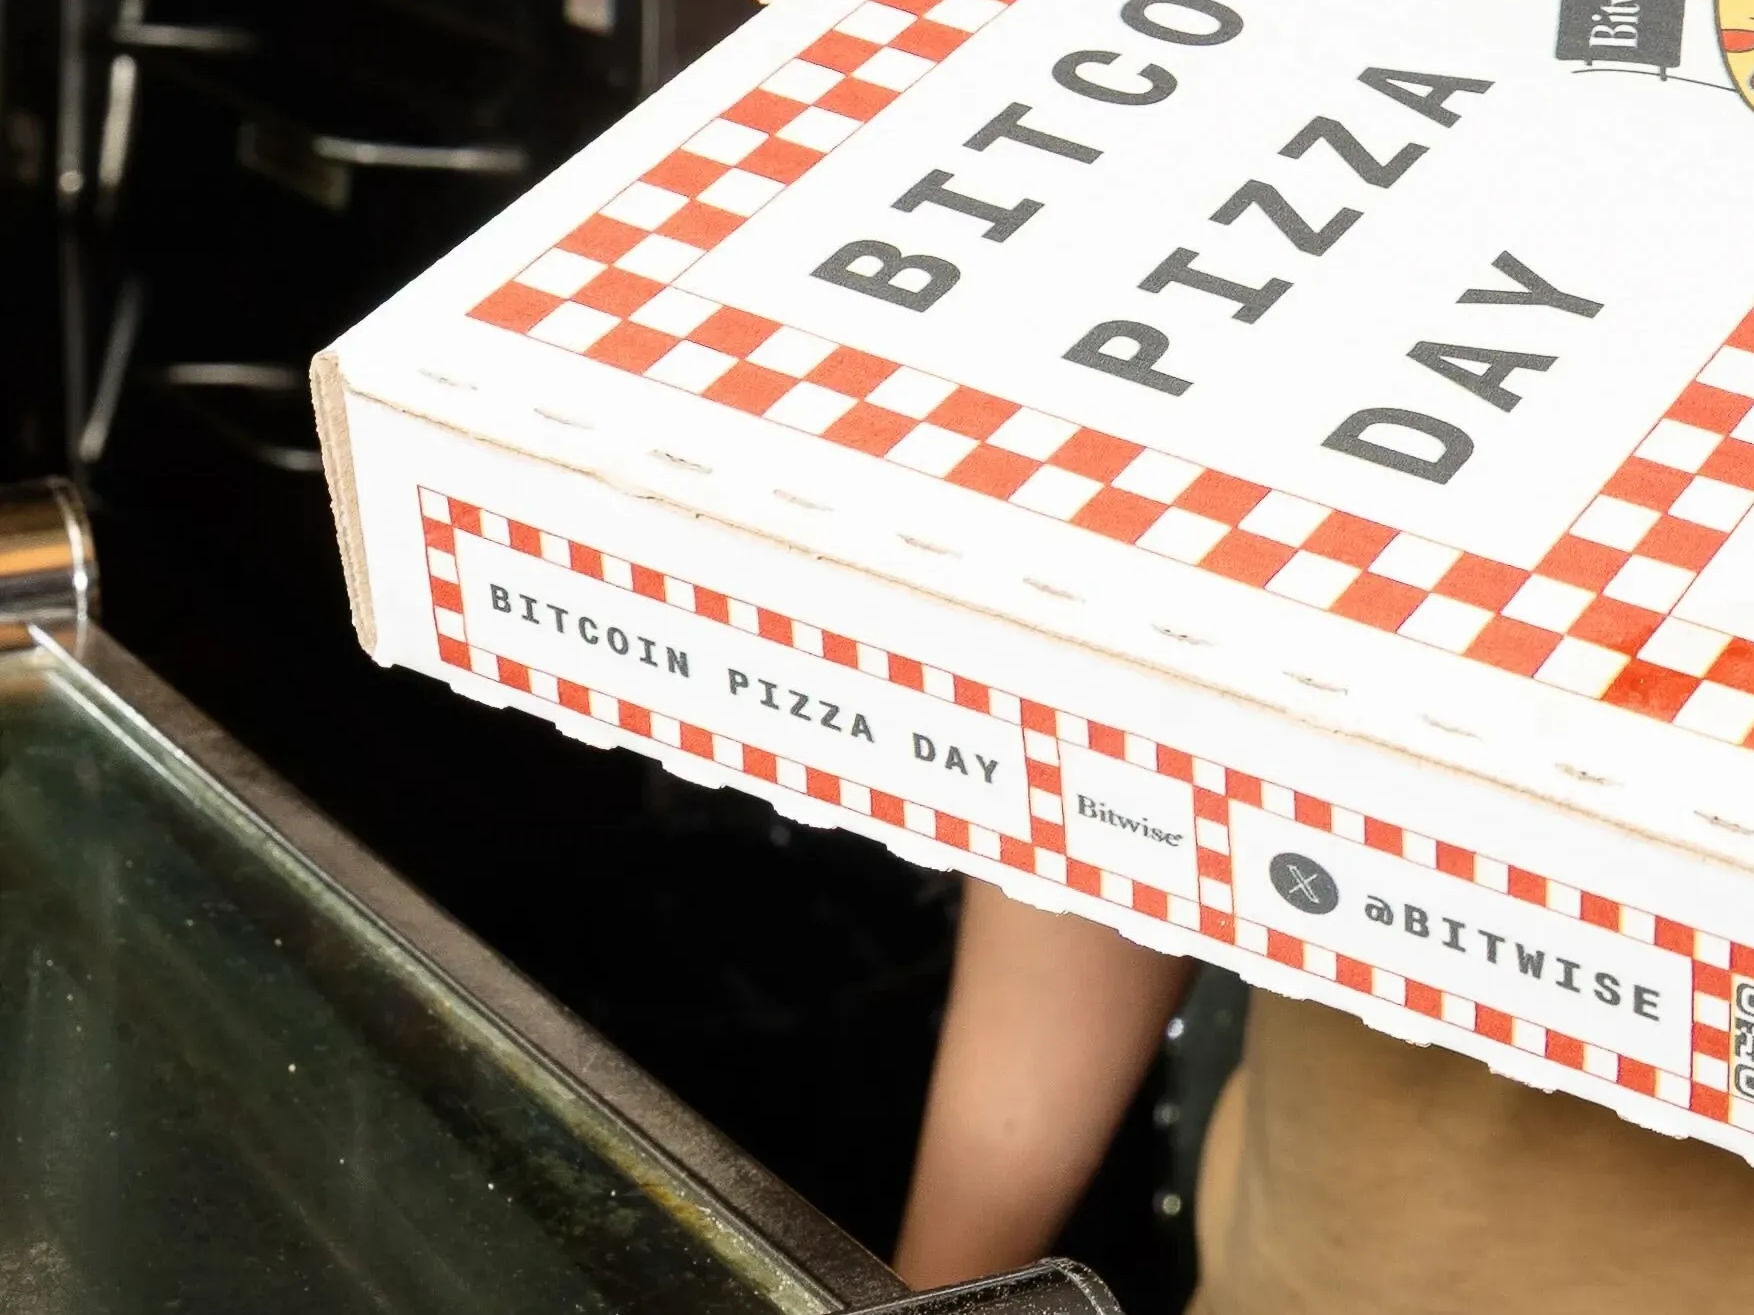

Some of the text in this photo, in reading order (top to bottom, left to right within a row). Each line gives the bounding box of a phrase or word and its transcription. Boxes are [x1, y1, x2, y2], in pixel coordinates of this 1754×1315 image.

[1061, 66, 1496, 398] PIZZA
[1321, 250, 1605, 485] DAY
[490, 583, 1000, 784] BITCOIN PIZZA DAY
[1363, 893, 1661, 1023] @BITWISE
